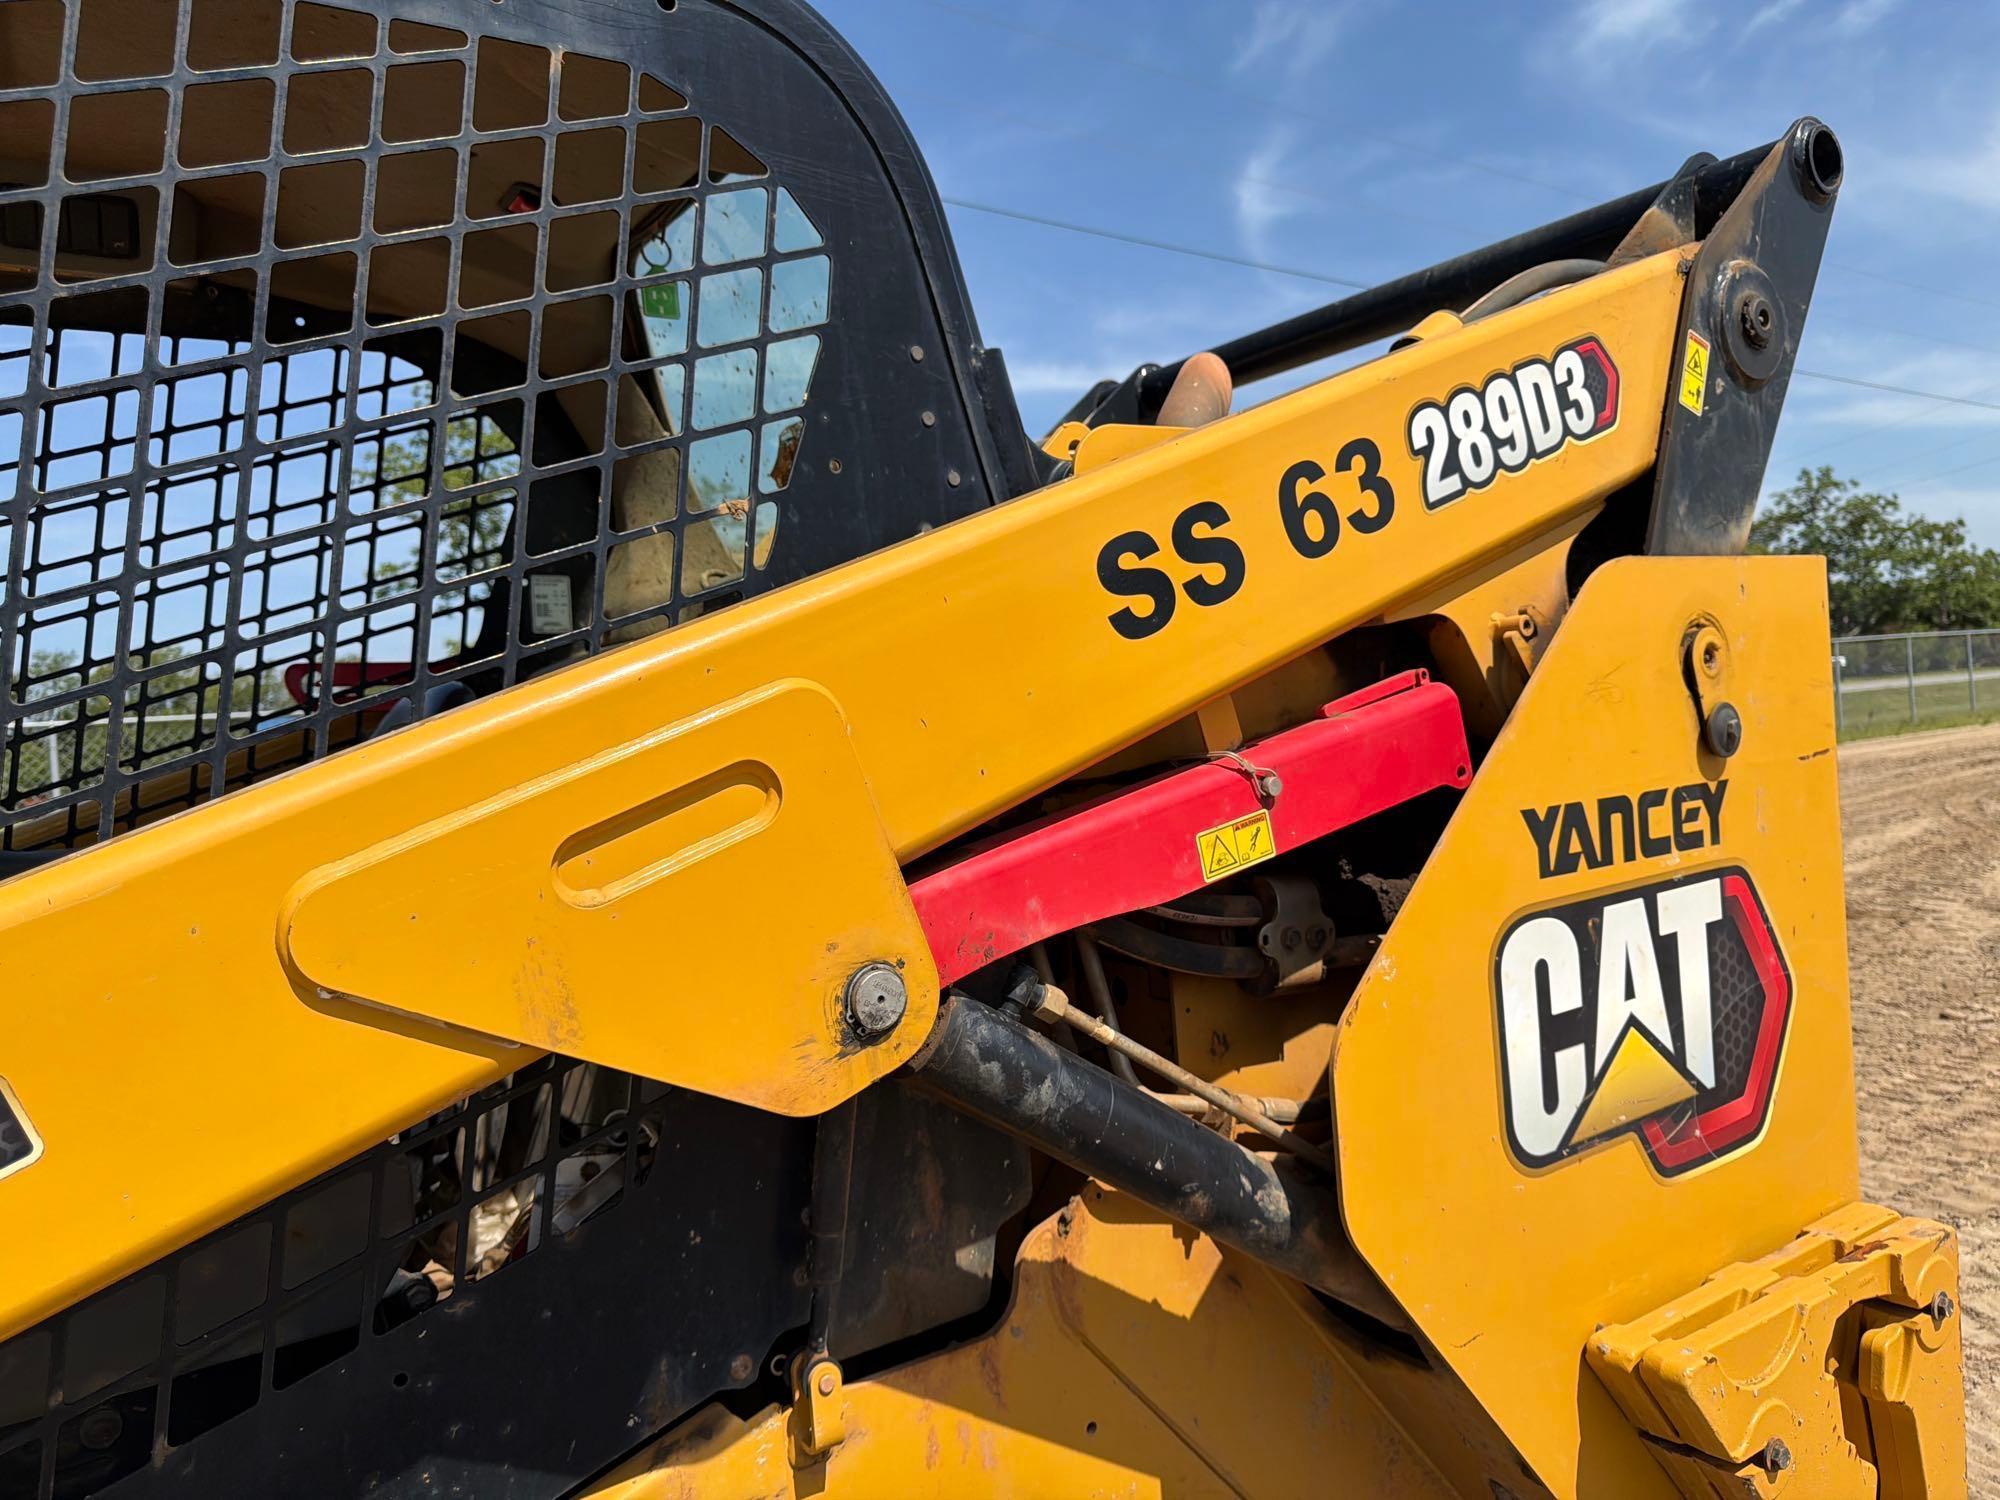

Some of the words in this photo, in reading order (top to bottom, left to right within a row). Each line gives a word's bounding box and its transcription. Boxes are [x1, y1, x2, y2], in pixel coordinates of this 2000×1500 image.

[1411, 349, 1596, 503] 289D3
[1096, 501, 1246, 640] SS
[1278, 437, 1396, 559] 63
[1519, 778, 1730, 880] YANCEY
[1500, 877, 1723, 1157] CAT
